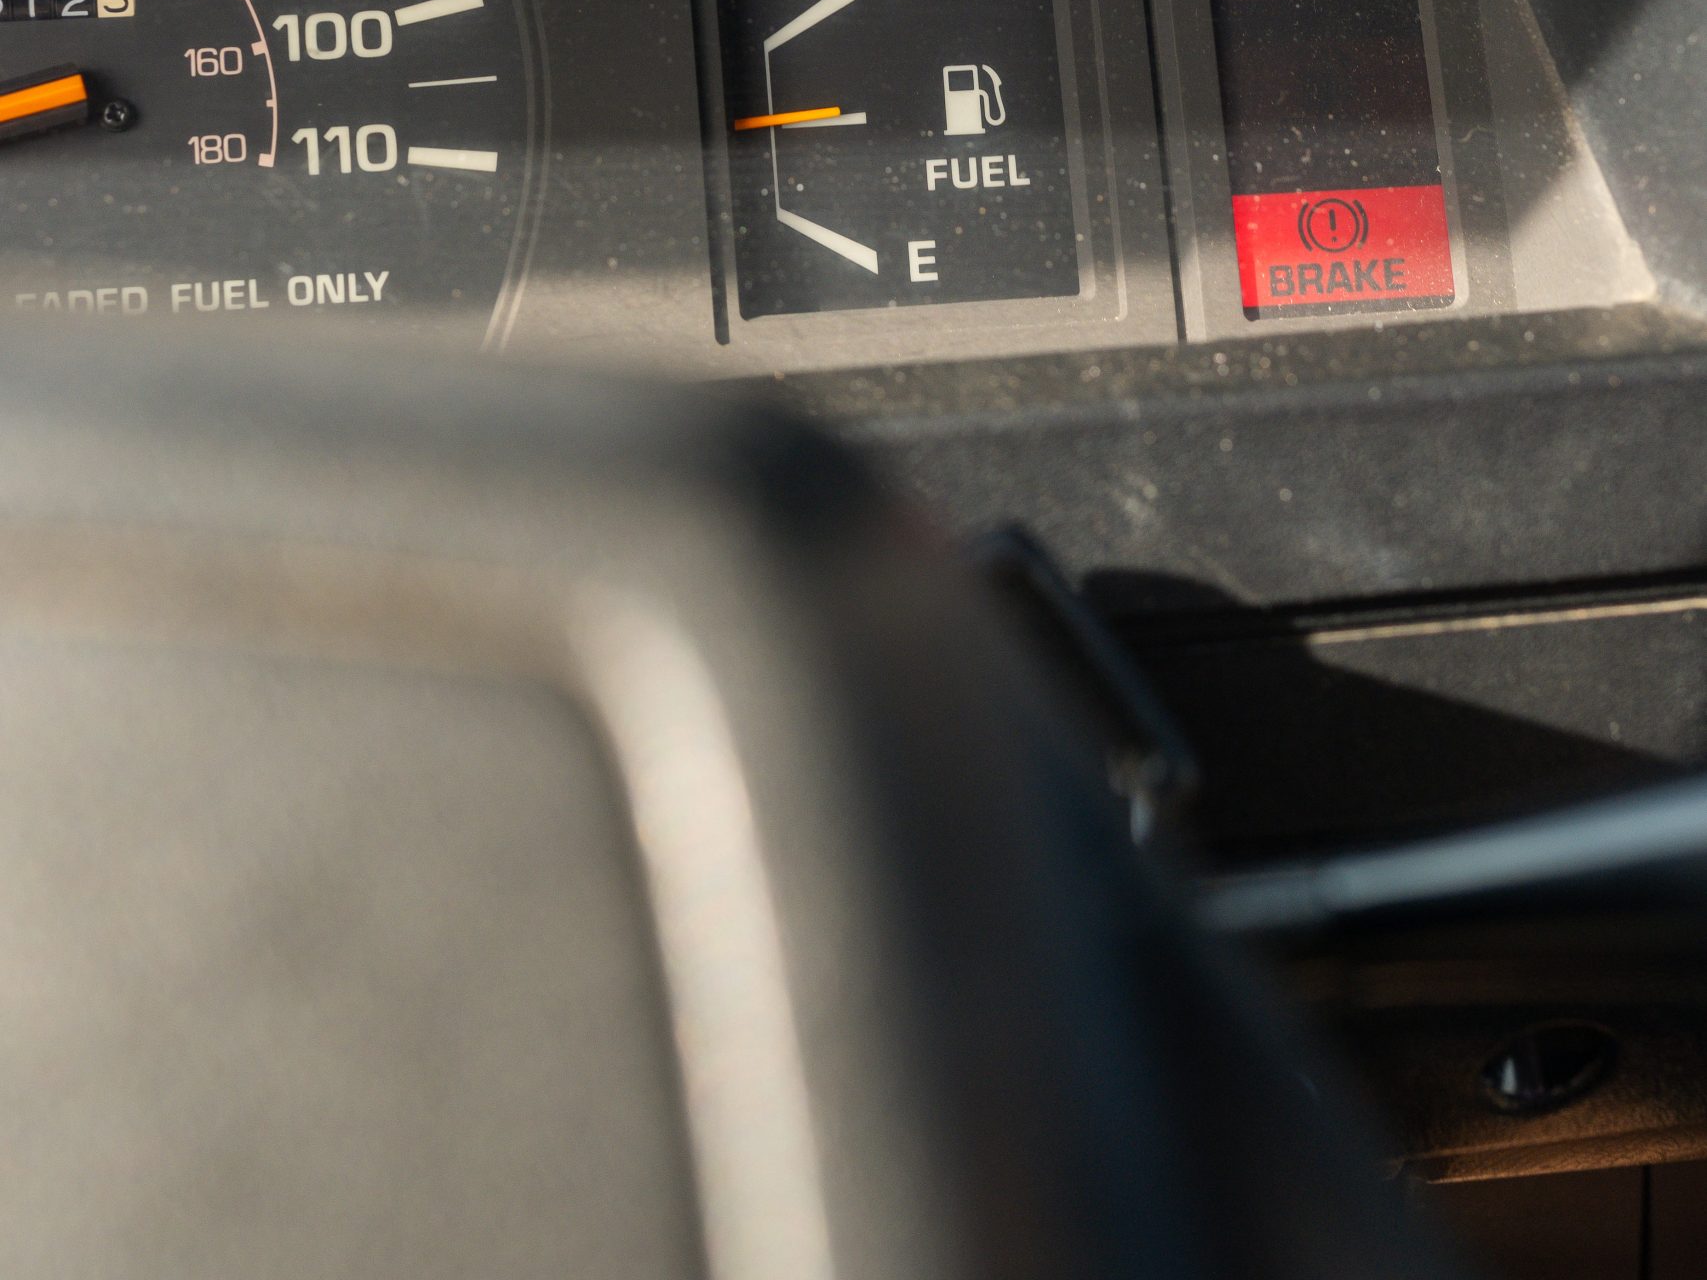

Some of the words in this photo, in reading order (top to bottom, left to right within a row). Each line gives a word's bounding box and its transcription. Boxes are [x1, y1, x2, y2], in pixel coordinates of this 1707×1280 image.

[271, 10, 394, 62] 100
[183, 46, 244, 78] 160
[188, 133, 248, 166] 180
[291, 123, 399, 176] 110
[924, 153, 1032, 192] FUEL
[907, 239, 941, 284] E
[1268, 257, 1408, 298] BRAKE
[171, 279, 269, 313] FUEL
[287, 271, 390, 306] ONLY
